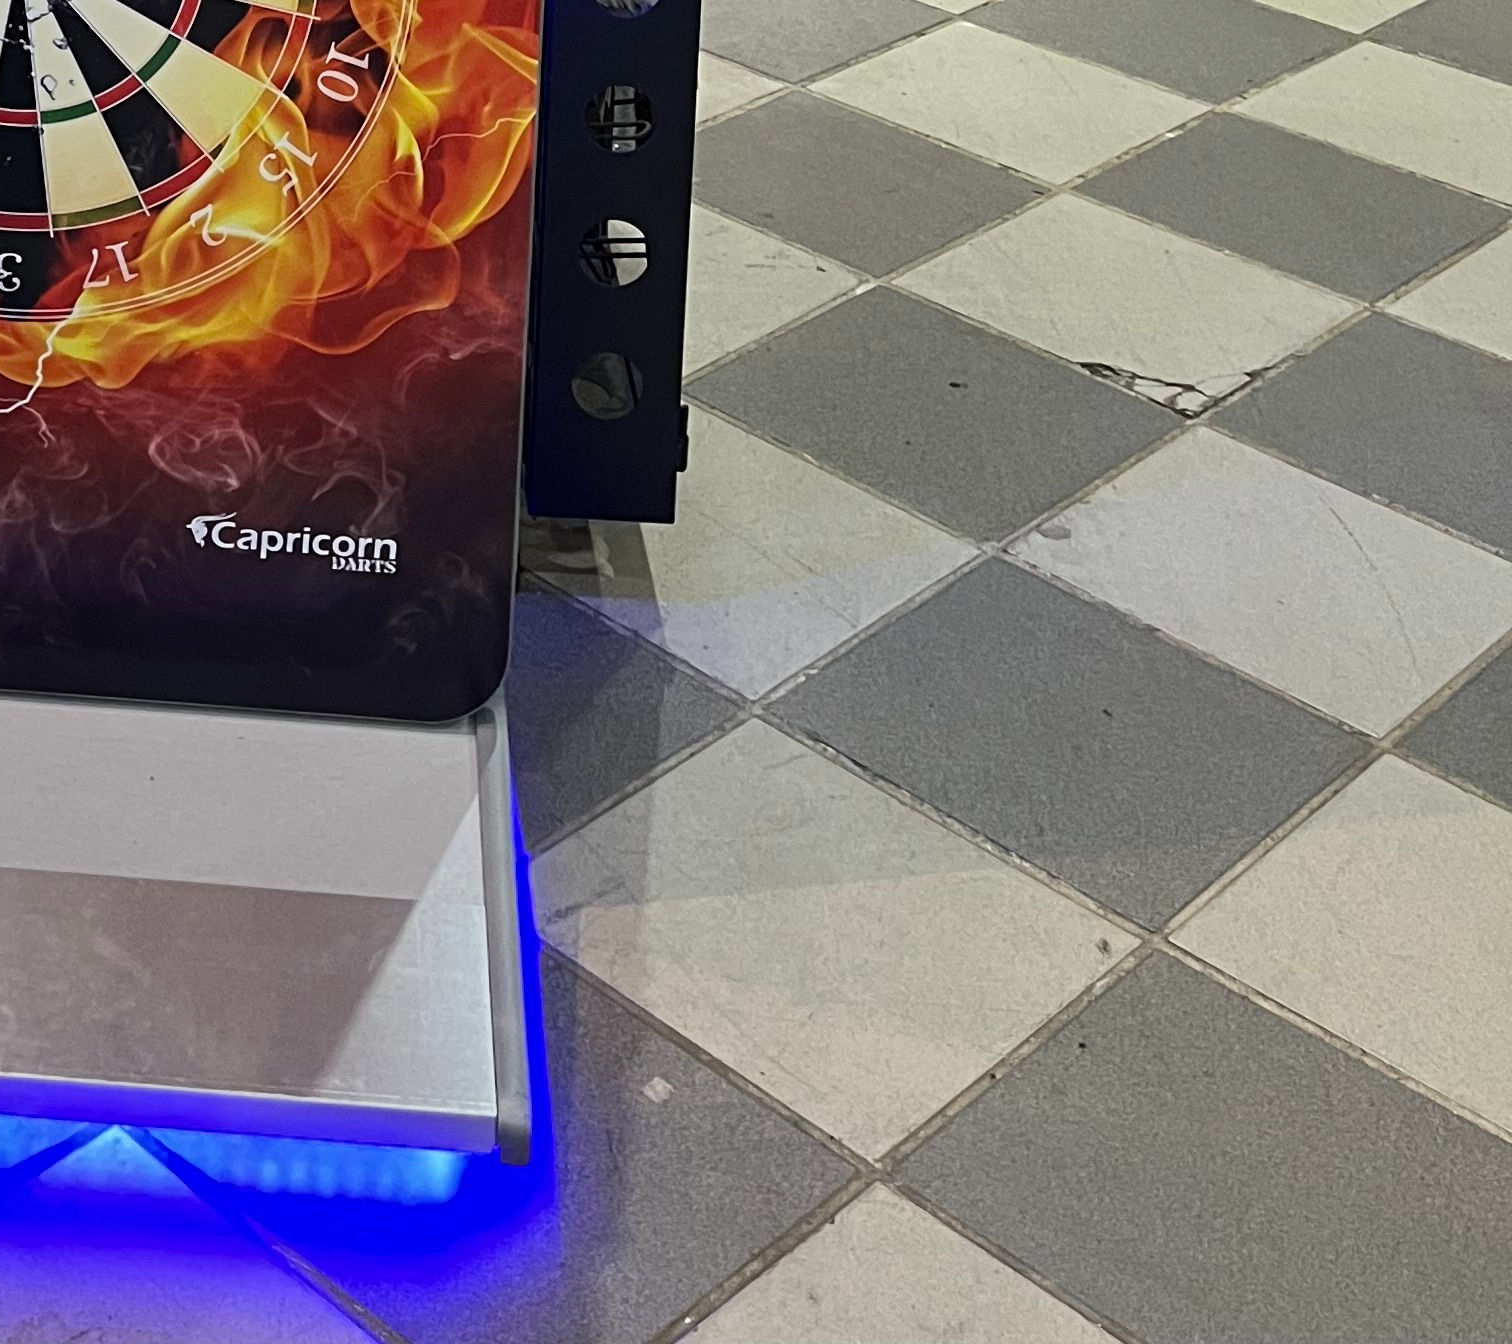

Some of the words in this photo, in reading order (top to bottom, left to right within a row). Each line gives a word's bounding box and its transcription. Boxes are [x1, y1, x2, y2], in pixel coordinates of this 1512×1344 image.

[317, 41, 371, 102] 10
[259, 131, 318, 197] 15
[190, 203, 228, 247] 2
[82, 240, 139, 290] 17
[211, 521, 397, 560] Capricorn
[331, 556, 397, 574] DARTS
